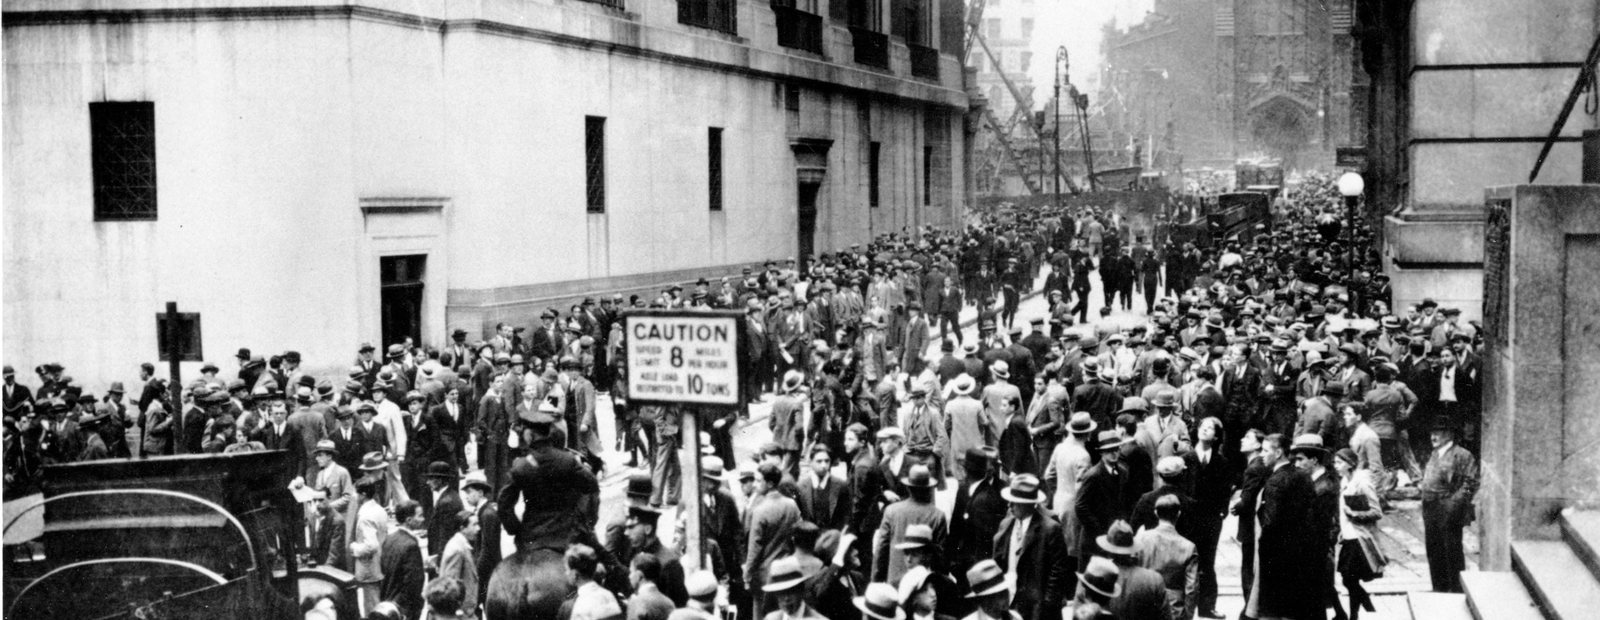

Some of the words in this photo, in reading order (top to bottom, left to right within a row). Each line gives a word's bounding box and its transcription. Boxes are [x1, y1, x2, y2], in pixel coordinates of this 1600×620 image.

[634, 322, 728, 342] CAUTION
[635, 358, 660, 367] LIMIT
[688, 359, 702, 368] PER
[705, 360, 728, 369] HOUR
[636, 346, 662, 354] SPEED
[670, 346, 684, 368] 8
[696, 348, 721, 356] MILES
[687, 374, 704, 395] 10
[706, 383, 731, 397] TONS
